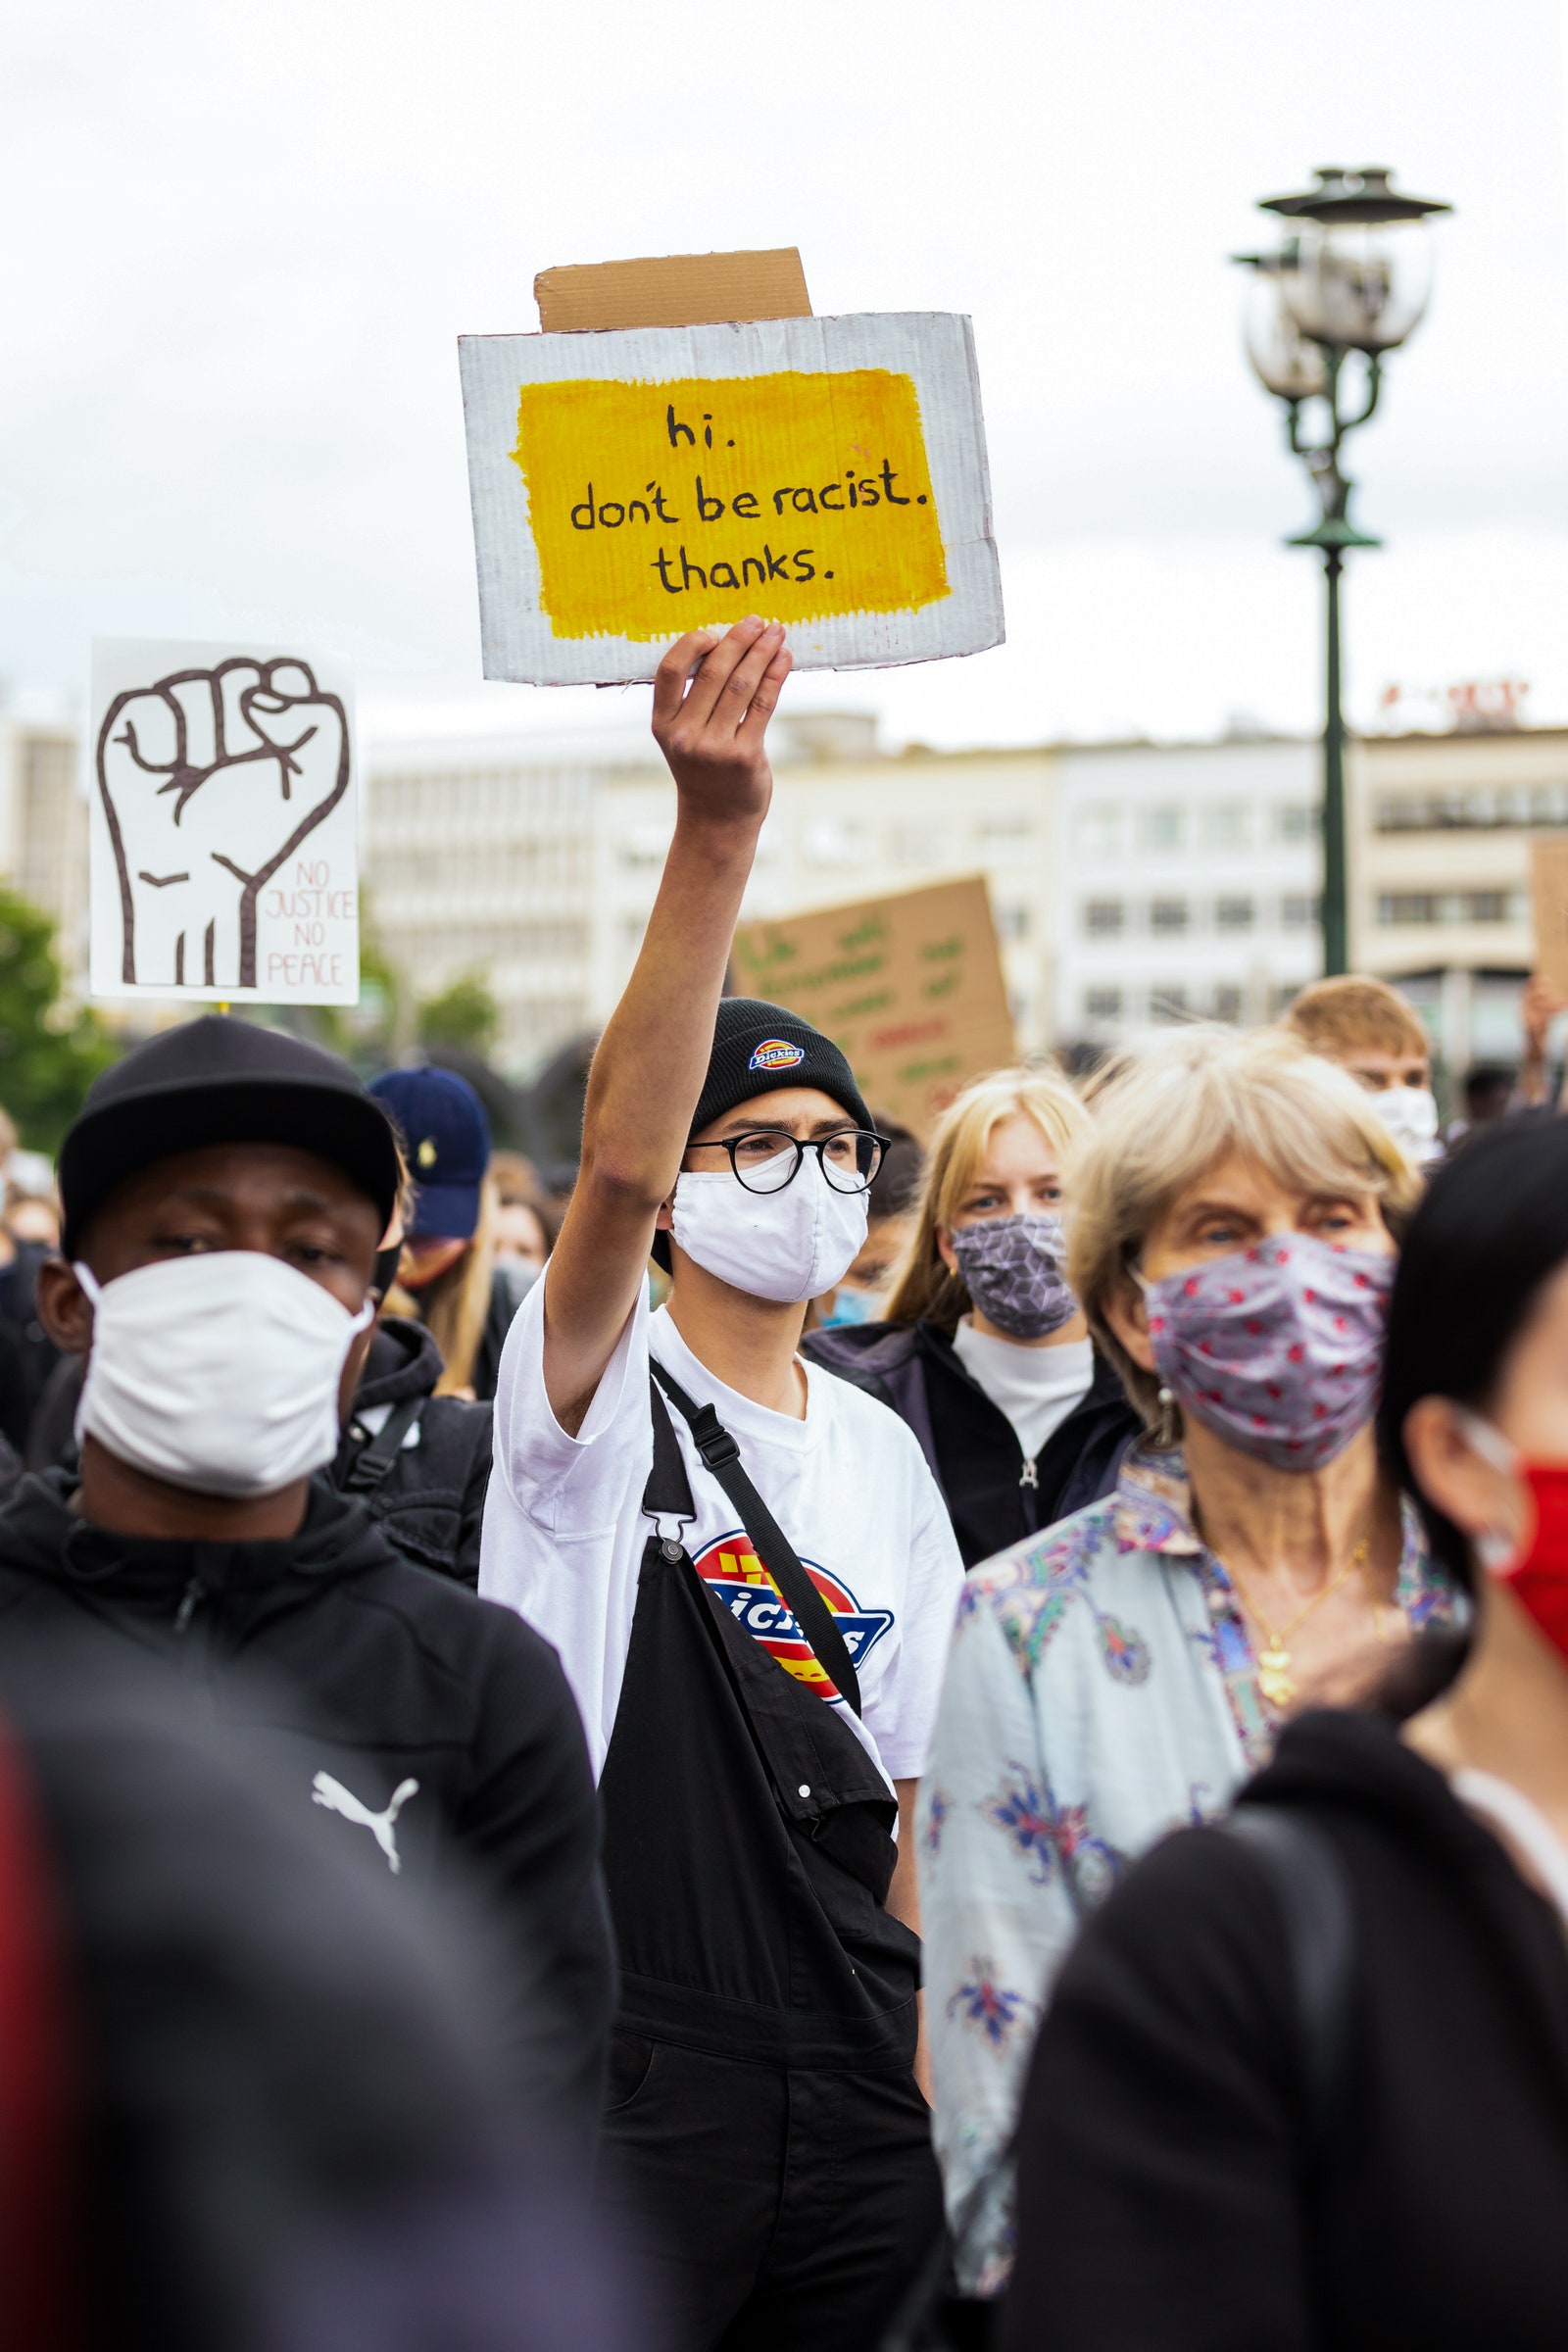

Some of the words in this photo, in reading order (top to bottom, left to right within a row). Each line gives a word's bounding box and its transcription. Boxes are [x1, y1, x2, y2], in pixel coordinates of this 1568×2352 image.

[666, 404, 735, 449] hi.
[570, 480, 679, 530] don't
[696, 474, 760, 521] be
[773, 459, 928, 516] racist.
[651, 544, 834, 594] thanks.
[296, 859, 331, 888] NO
[265, 889, 357, 920] JUSTICE
[294, 921, 325, 947] NO
[268, 952, 344, 987] PEACE
[754, 1049, 801, 1065] Dickies
